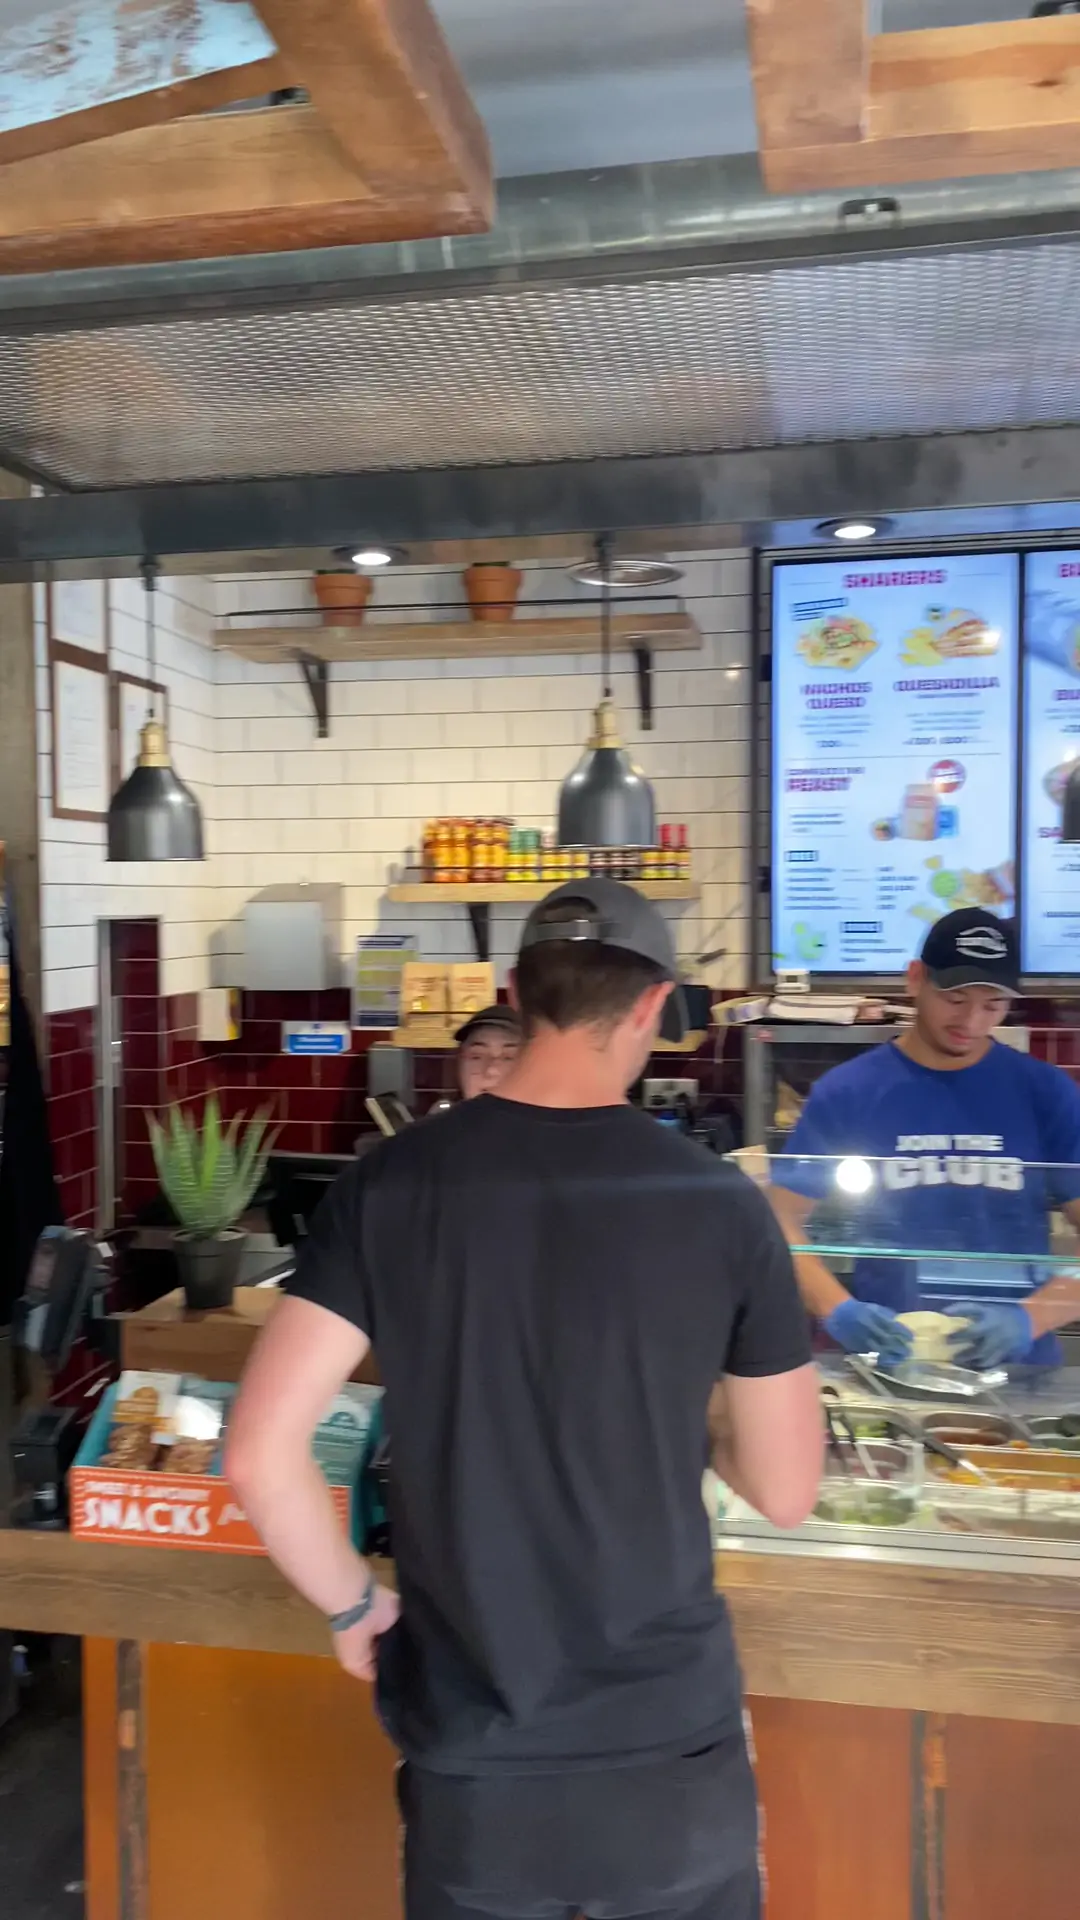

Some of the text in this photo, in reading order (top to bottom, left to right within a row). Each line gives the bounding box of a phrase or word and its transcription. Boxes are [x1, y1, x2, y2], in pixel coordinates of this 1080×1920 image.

[895, 1134, 1004, 1152] JOIN THE
[884, 1156, 1024, 1190] CLUB
[83, 1498, 210, 1537] SNACKS
